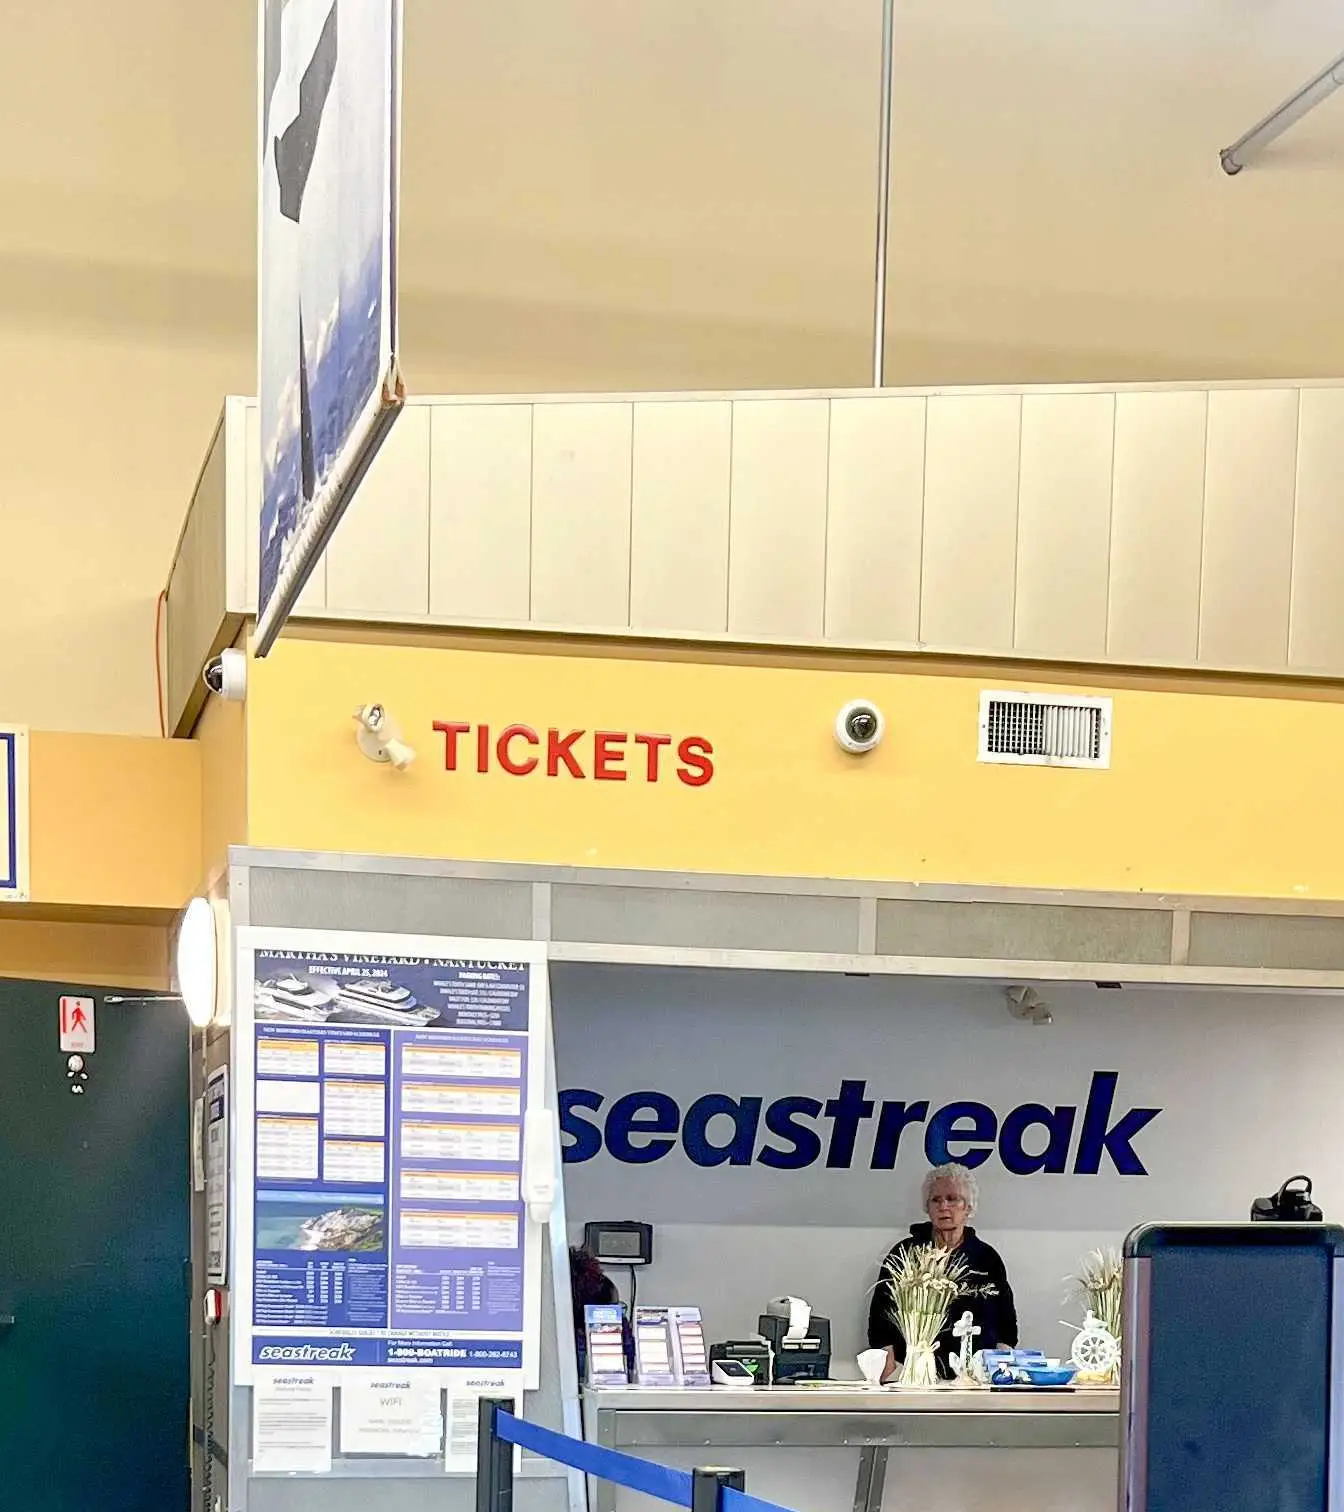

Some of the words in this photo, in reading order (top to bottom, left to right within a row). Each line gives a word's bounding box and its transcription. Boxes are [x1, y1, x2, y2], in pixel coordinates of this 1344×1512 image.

[431, 719, 714, 787] TICKETS
[259, 950, 337, 960] MARTHAS
[309, 966, 341, 975] EFFECTIVE
[558, 1071, 1162, 1175] seastreak
[259, 1343, 356, 1360] seastreak
[388, 1348, 467, 1358] 1-800-BOATRIDE
[370, 1381, 411, 1389] seastreak
[466, 1379, 505, 1387] seastreak
[381, 1398, 402, 1406] WIFI
